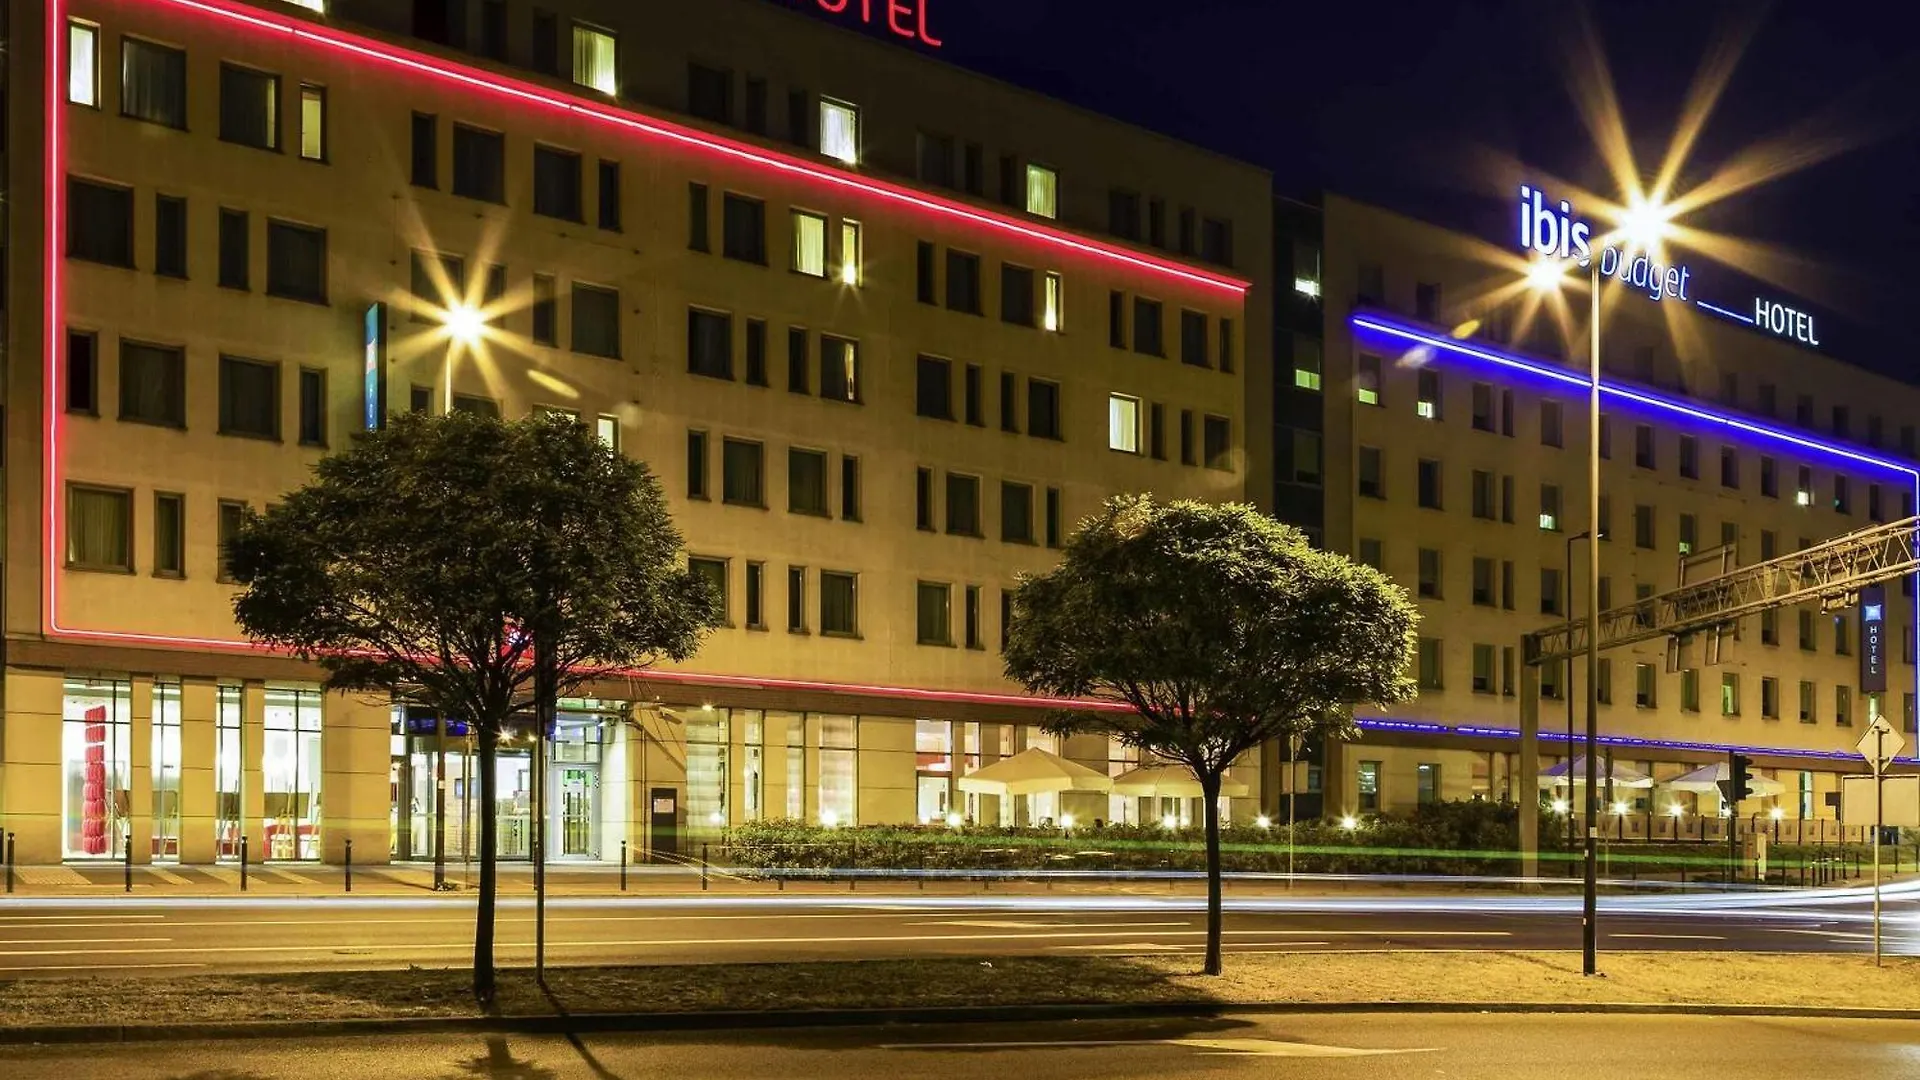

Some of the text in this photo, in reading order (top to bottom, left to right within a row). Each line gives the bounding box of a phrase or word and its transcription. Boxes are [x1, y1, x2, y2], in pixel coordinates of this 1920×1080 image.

[1521, 185, 1591, 267] ibis
[1755, 297, 1819, 345] HOTEL
[1869, 625, 1878, 674] HOTEL
